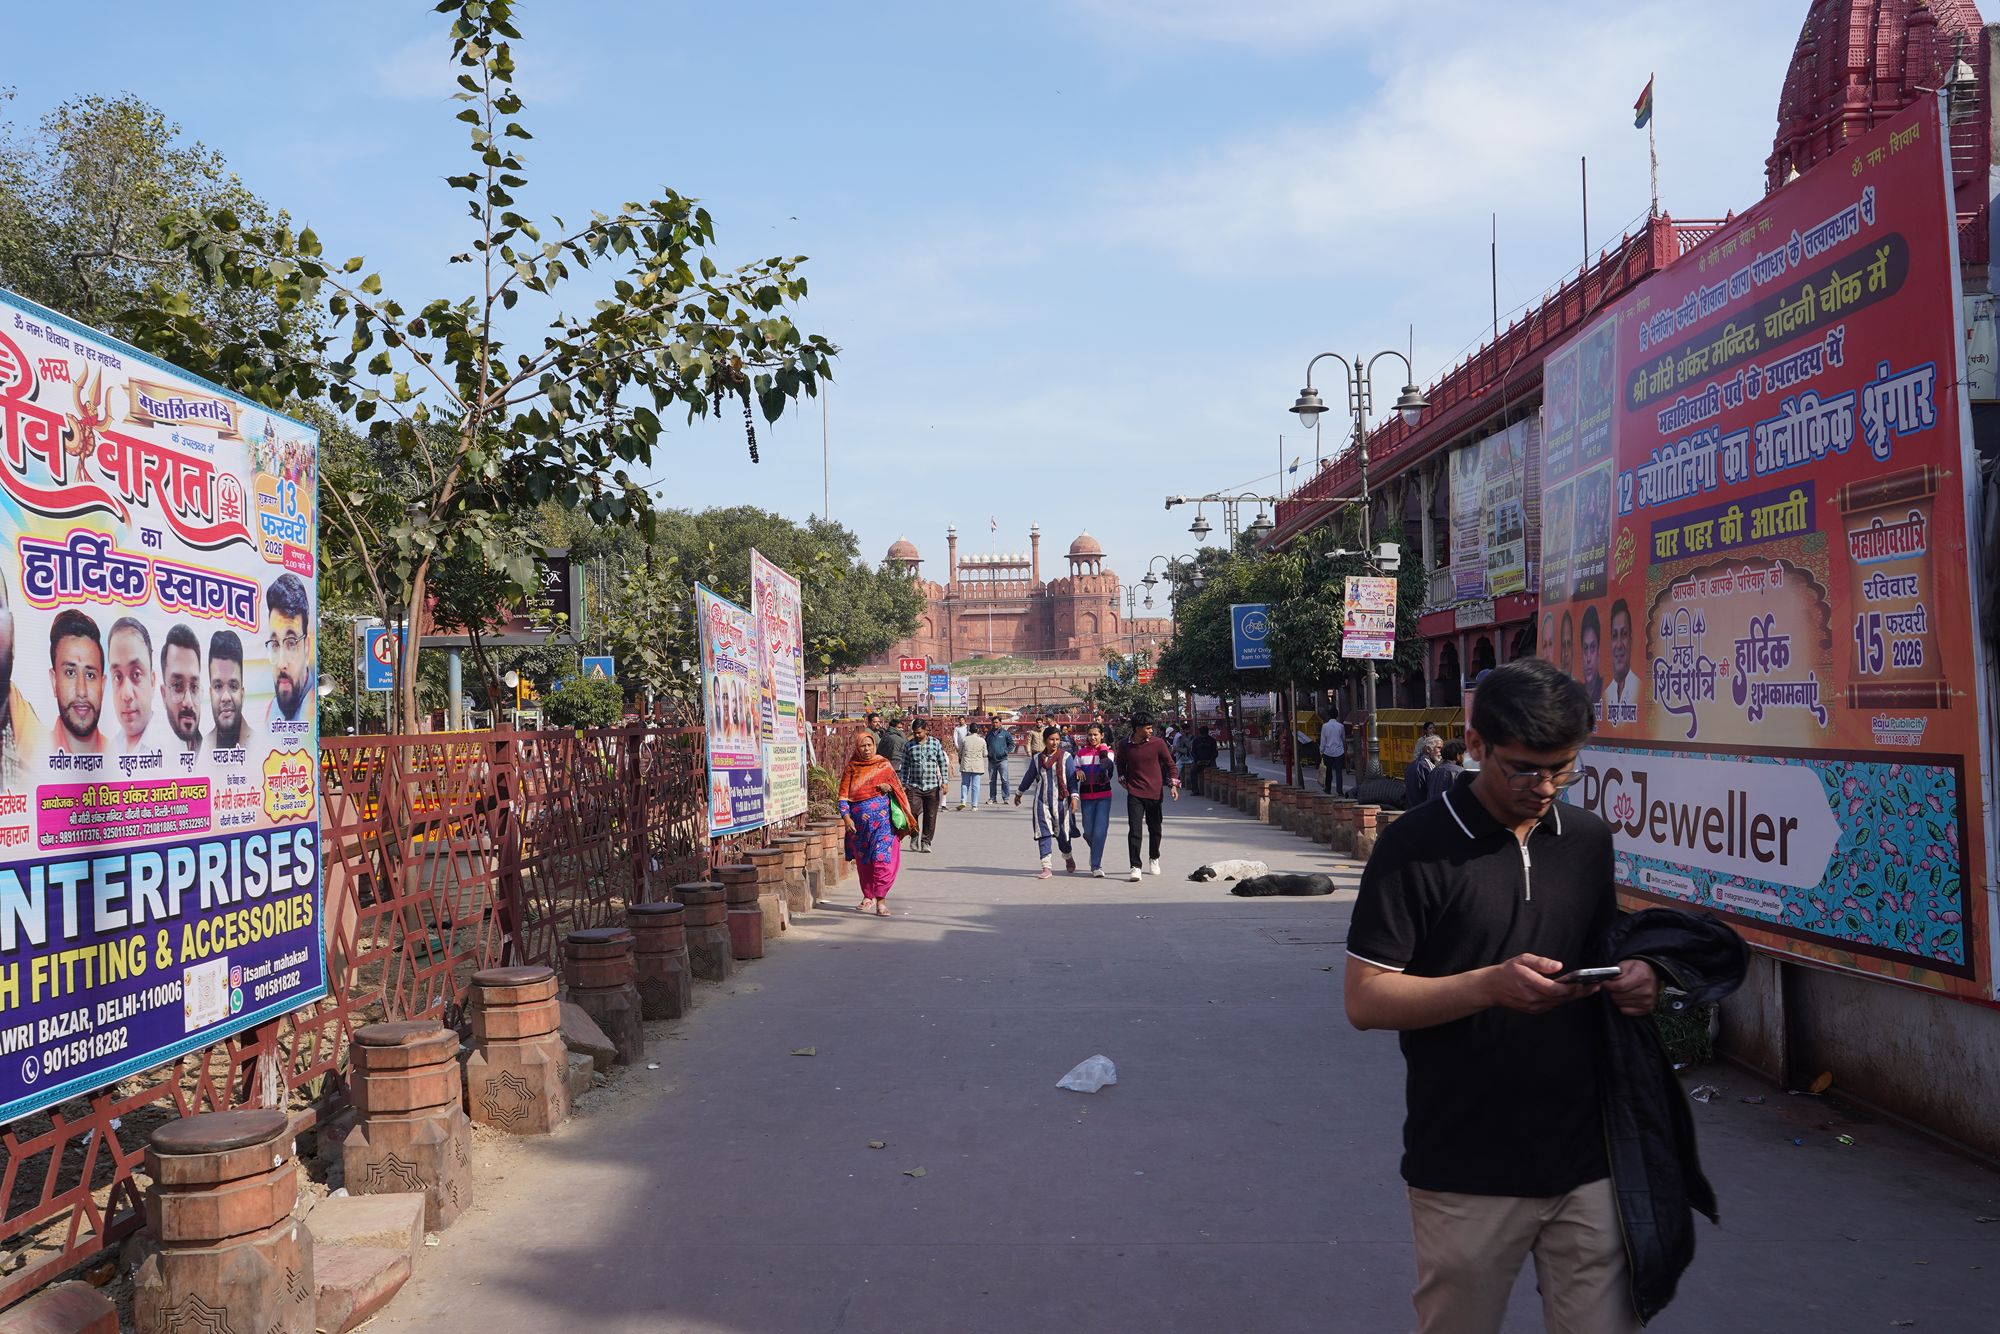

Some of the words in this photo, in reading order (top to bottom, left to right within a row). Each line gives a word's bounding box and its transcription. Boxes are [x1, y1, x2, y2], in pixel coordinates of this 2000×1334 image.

[1866, 146, 1886, 167] नमः
[1888, 121, 1921, 154] शिवाय
[1699, 286, 1728, 317] शिवाला
[1730, 269, 1750, 297] आपा
[1752, 251, 1785, 285] गंगाधर
[1789, 234, 1801, 263] के
[1863, 188, 1875, 225] में
[1632, 376, 1648, 404] श्री
[1649, 355, 1674, 394] गौरी
[1677, 344, 1711, 383] शंकर
[1711, 323, 1761, 363] मन्दिर,
[1764, 287, 1816, 340] चांदनी
[1820, 270, 1863, 314] चौक
[1867, 244, 1890, 290] में
[26, 321, 44, 338] नमः
[45, 327, 70, 350] शिवाय
[74, 342, 84, 357] हर
[86, 347, 96, 361] हर
[97, 351, 122, 371] महादेव
[1967, 353, 1990, 367] (पंजी)
[38, 357, 71, 384] भव्य
[1658, 383, 1720, 433] महाशिवरात्रि
[1724, 373, 1743, 408] पर्व
[1747, 365, 1762, 397] के
[1826, 326, 1843, 365] में
[138, 389, 232, 427] महाशिवरात्रि
[1617, 470, 1632, 514] 12
[1721, 430, 1750, 483] का
[1755, 392, 1855, 474] अलौकिक
[276, 479, 297, 517] 13
[141, 527, 162, 549] का
[260, 512, 308, 544] फरवरी
[1655, 529, 1678, 559] चार
[1683, 519, 1713, 551] पहर
[1719, 504, 1744, 543] की
[1750, 488, 1809, 538] आरती
[1850, 511, 1926, 560] महाशिवरात्रि
[265, 540, 282, 555] 2026
[22, 534, 147, 597] हार्दिक
[155, 570, 257, 624] स्वागत
[1672, 575, 1697, 601] आपको
[1700, 580, 1706, 595] व
[1710, 571, 1734, 595] आपके
[1737, 565, 1766, 590] परिवार
[1770, 561, 1784, 586] को
[1864, 573, 1918, 600] रविवार
[1672, 645, 1694, 668] महा
[1855, 612, 1884, 673] 15
[1886, 605, 1926, 634] फरवरी
[1892, 640, 1923, 666] 2026
[1732, 613, 1790, 706] हार्दिक
[1653, 655, 1716, 739] शिवरात्रि
[1719, 658, 1730, 678] की
[1748, 671, 1828, 725] शुभकामनाएं
[1873, 714, 1890, 730] Raju
[1891, 717, 1927, 731] Publicity
[49, 749, 72, 771] नवीन
[74, 755, 104, 771] भारद्वाज
[118, 755, 137, 777] राहुल
[139, 749, 163, 769] रस्तोगी
[82, 785, 96, 806] श्री
[98, 785, 121, 806] शिव
[122, 784, 149, 804] शंकर
[150, 781, 178, 802] आरती
[180, 785, 208, 799] मण्डल
[294, 800, 306, 809] 2026
[32, 933, 147, 1004] FITTING
[155, 929, 173, 970] &
[179, 892, 314, 963] ACCESSORIES
[244, 946, 309, 983] itsamit_mahakaal
[255, 970, 301, 1001] 9015818282
[39, 1007, 94, 1044] BAZAR,
[97, 979, 182, 1027] DELHI-110006
[43, 1025, 128, 1075] 9015818282
